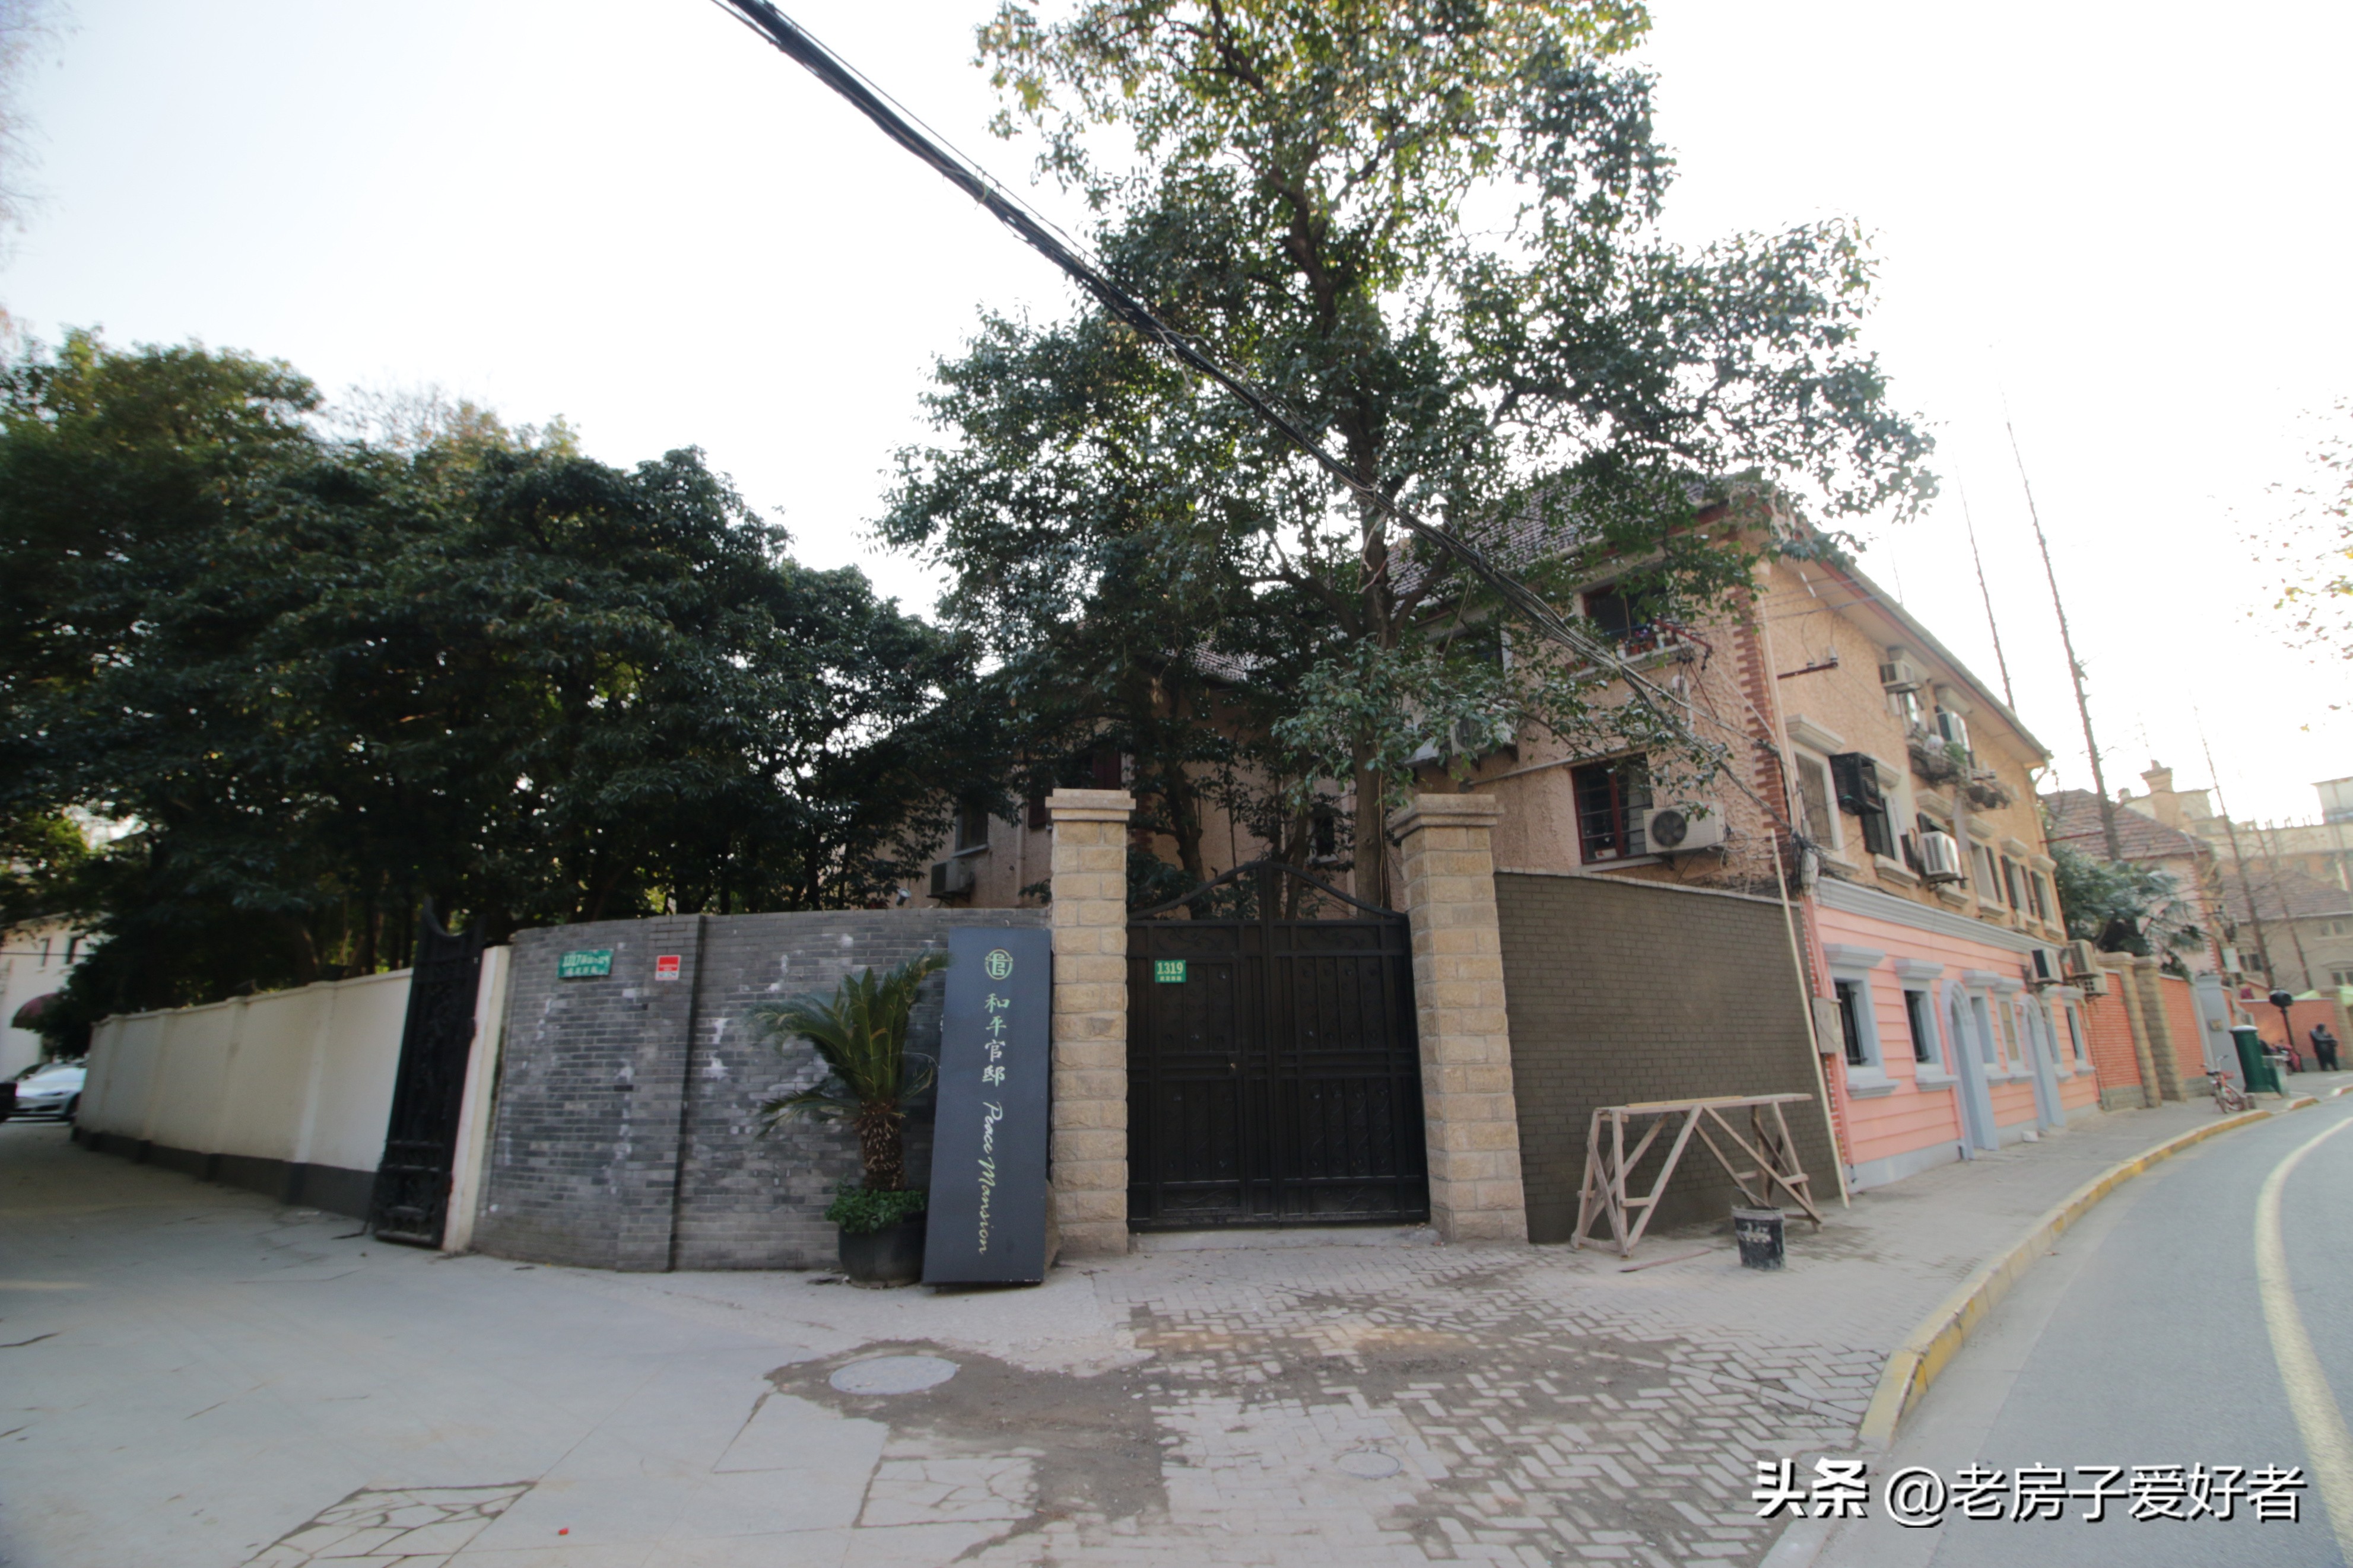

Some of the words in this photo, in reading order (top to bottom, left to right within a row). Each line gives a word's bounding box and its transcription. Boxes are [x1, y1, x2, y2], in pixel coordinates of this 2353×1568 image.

[1157, 962, 1183, 975] 1319
[982, 993, 1010, 1087] 和平官邸
[982, 1101, 1003, 1154] Peace
[978, 1157, 996, 1255] Mansion
